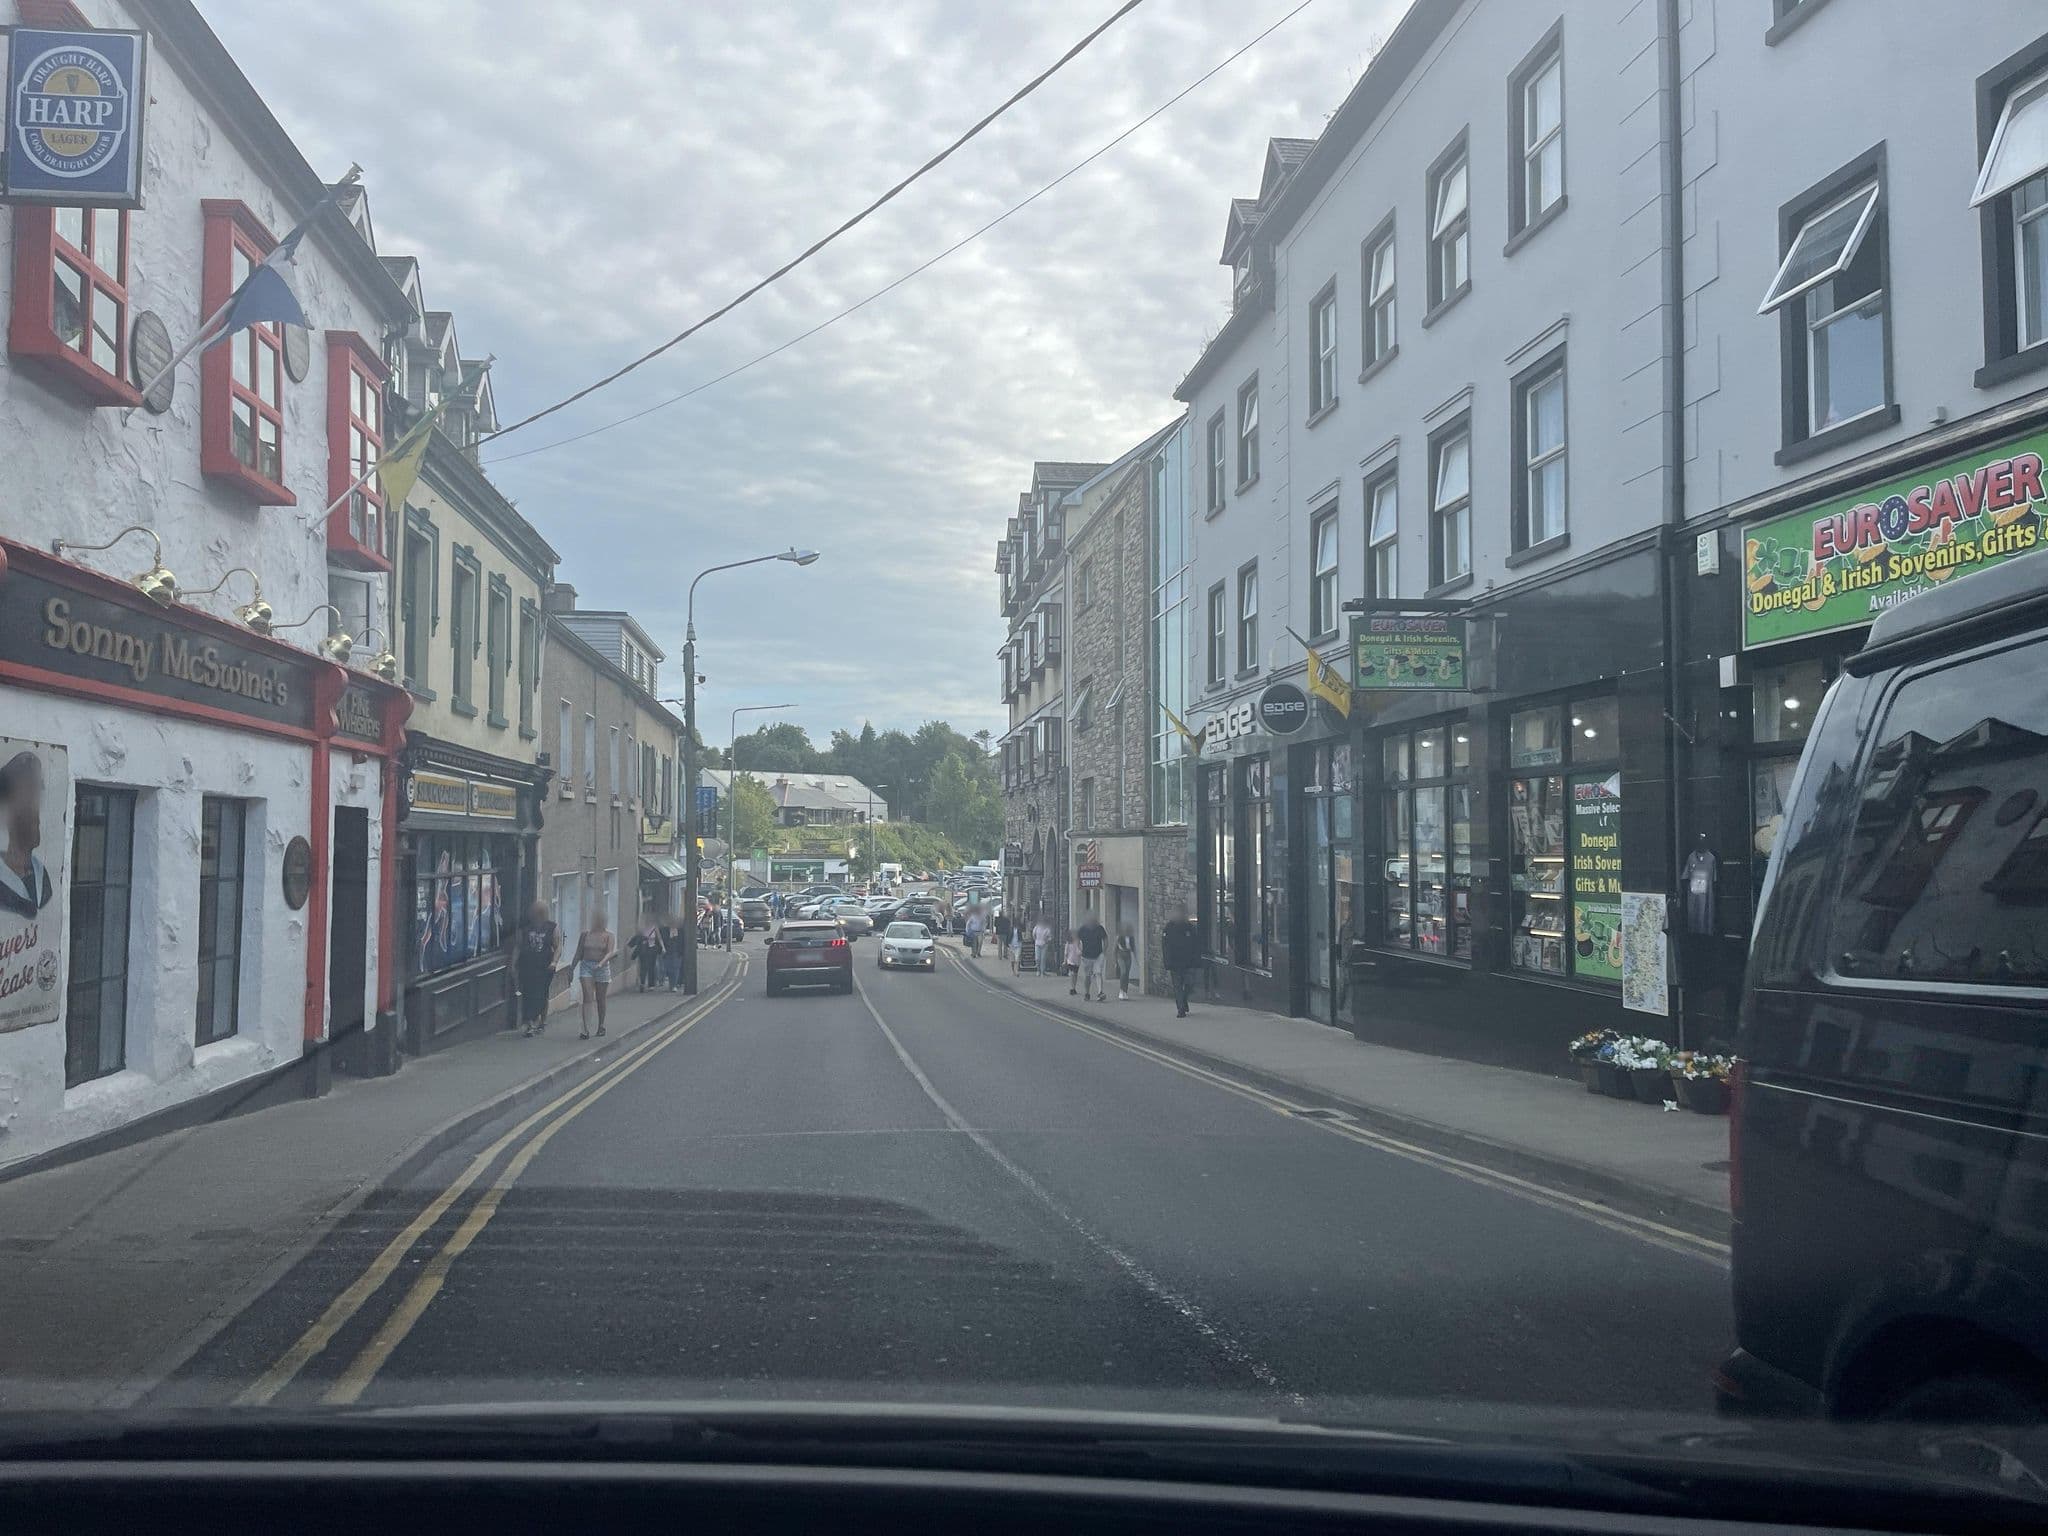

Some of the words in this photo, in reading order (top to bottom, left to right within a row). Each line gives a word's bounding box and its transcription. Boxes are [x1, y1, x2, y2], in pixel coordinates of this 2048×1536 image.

[33, 54, 86, 85] DRAUGHT
[86, 59, 112, 87] HARP
[27, 97, 114, 126] HARP
[52, 133, 88, 145] LAGER
[30, 132, 45, 156] COOL
[44, 154, 90, 170] DRAUGHT
[1813, 453, 2045, 560] EUROSAVER
[1752, 583, 1816, 614] Donegal
[1822, 573, 1836, 596] &
[1841, 560, 1882, 590] Irish
[1370, 619, 1447, 632] EUROSAVER
[1360, 634, 1392, 644] Donegal
[1403, 633, 1421, 642] Irish
[44, 597, 152, 682] Sonny
[162, 632, 289, 706] McSwine's
[1576, 803, 1600, 815] Massive
[1581, 832, 1617, 851] Donegal
[1574, 856, 1592, 870] Irish
[1576, 878, 1595, 893] Gifts
[1598, 878, 1606, 892] &
